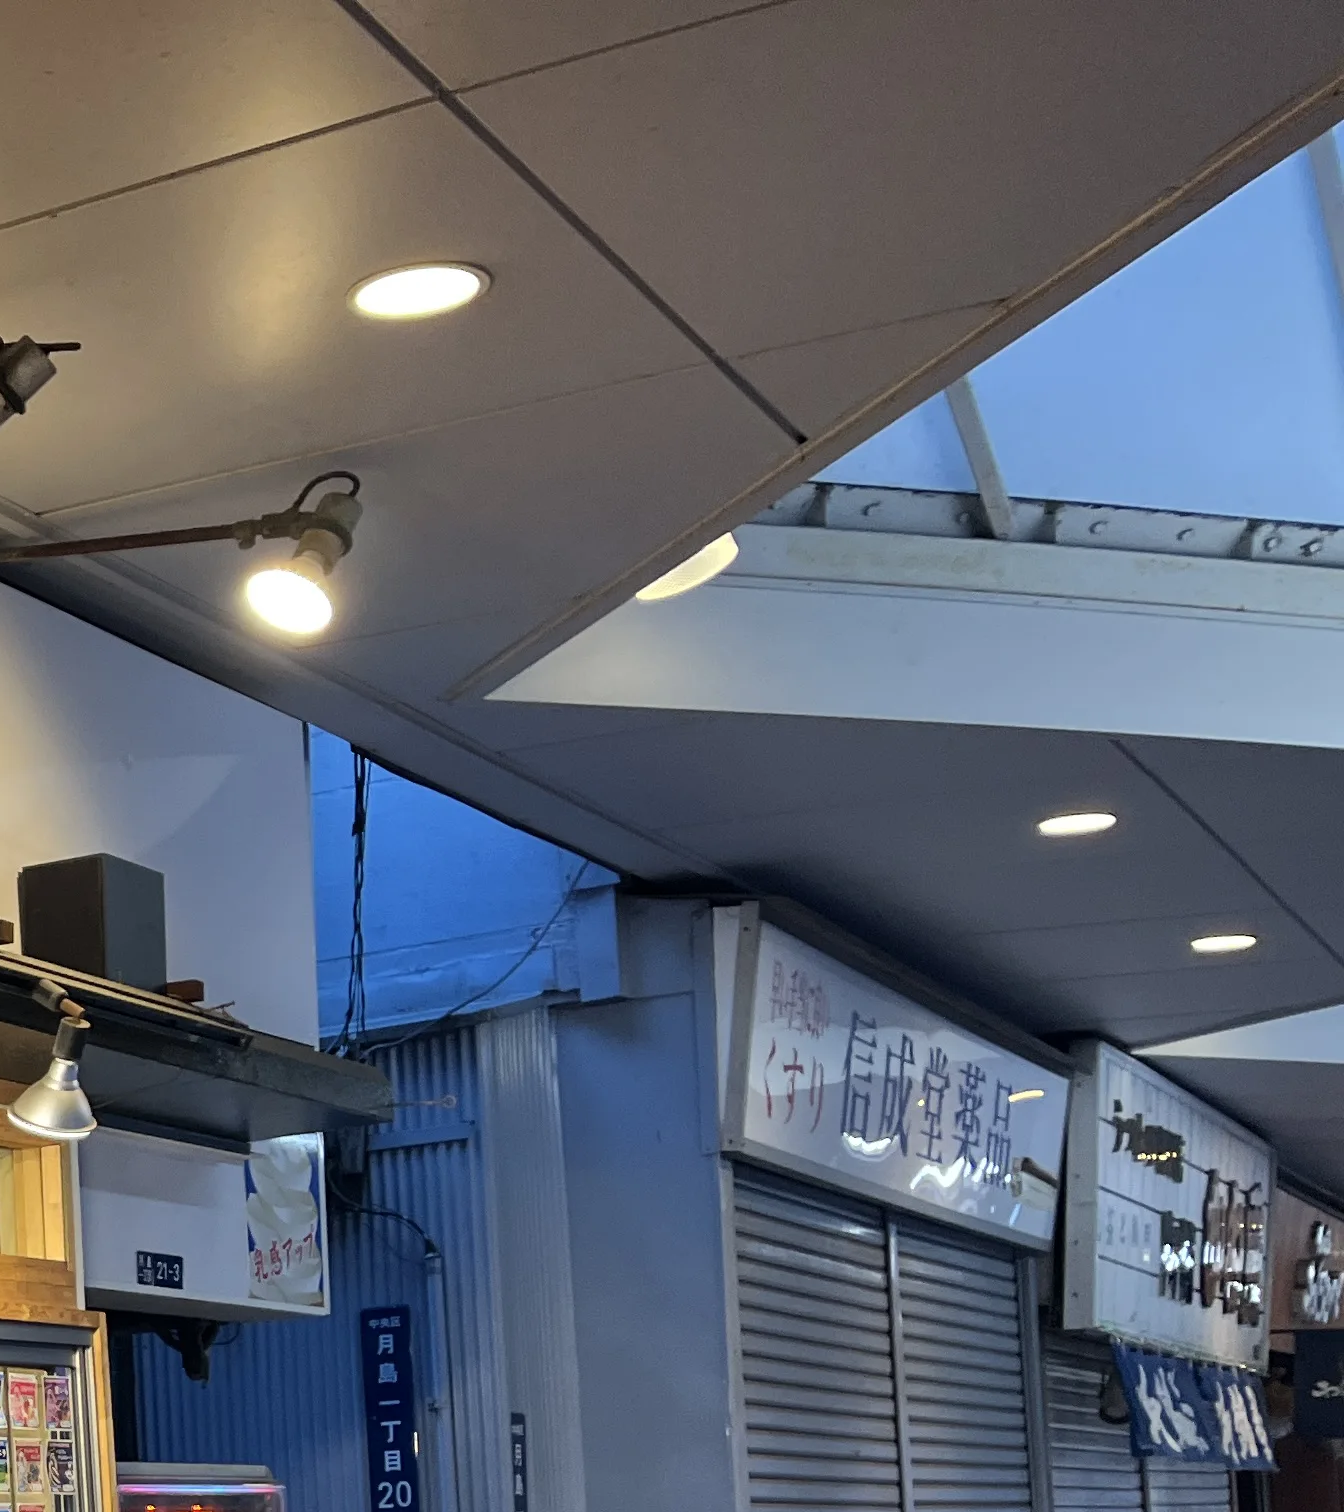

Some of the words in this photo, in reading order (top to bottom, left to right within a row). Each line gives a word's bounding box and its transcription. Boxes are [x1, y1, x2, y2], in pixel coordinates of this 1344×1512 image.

[156, 1260, 181, 1283] 21-3
[376, 1333, 402, 1472] 月島一丁目
[377, 1480, 412, 1509] 20
